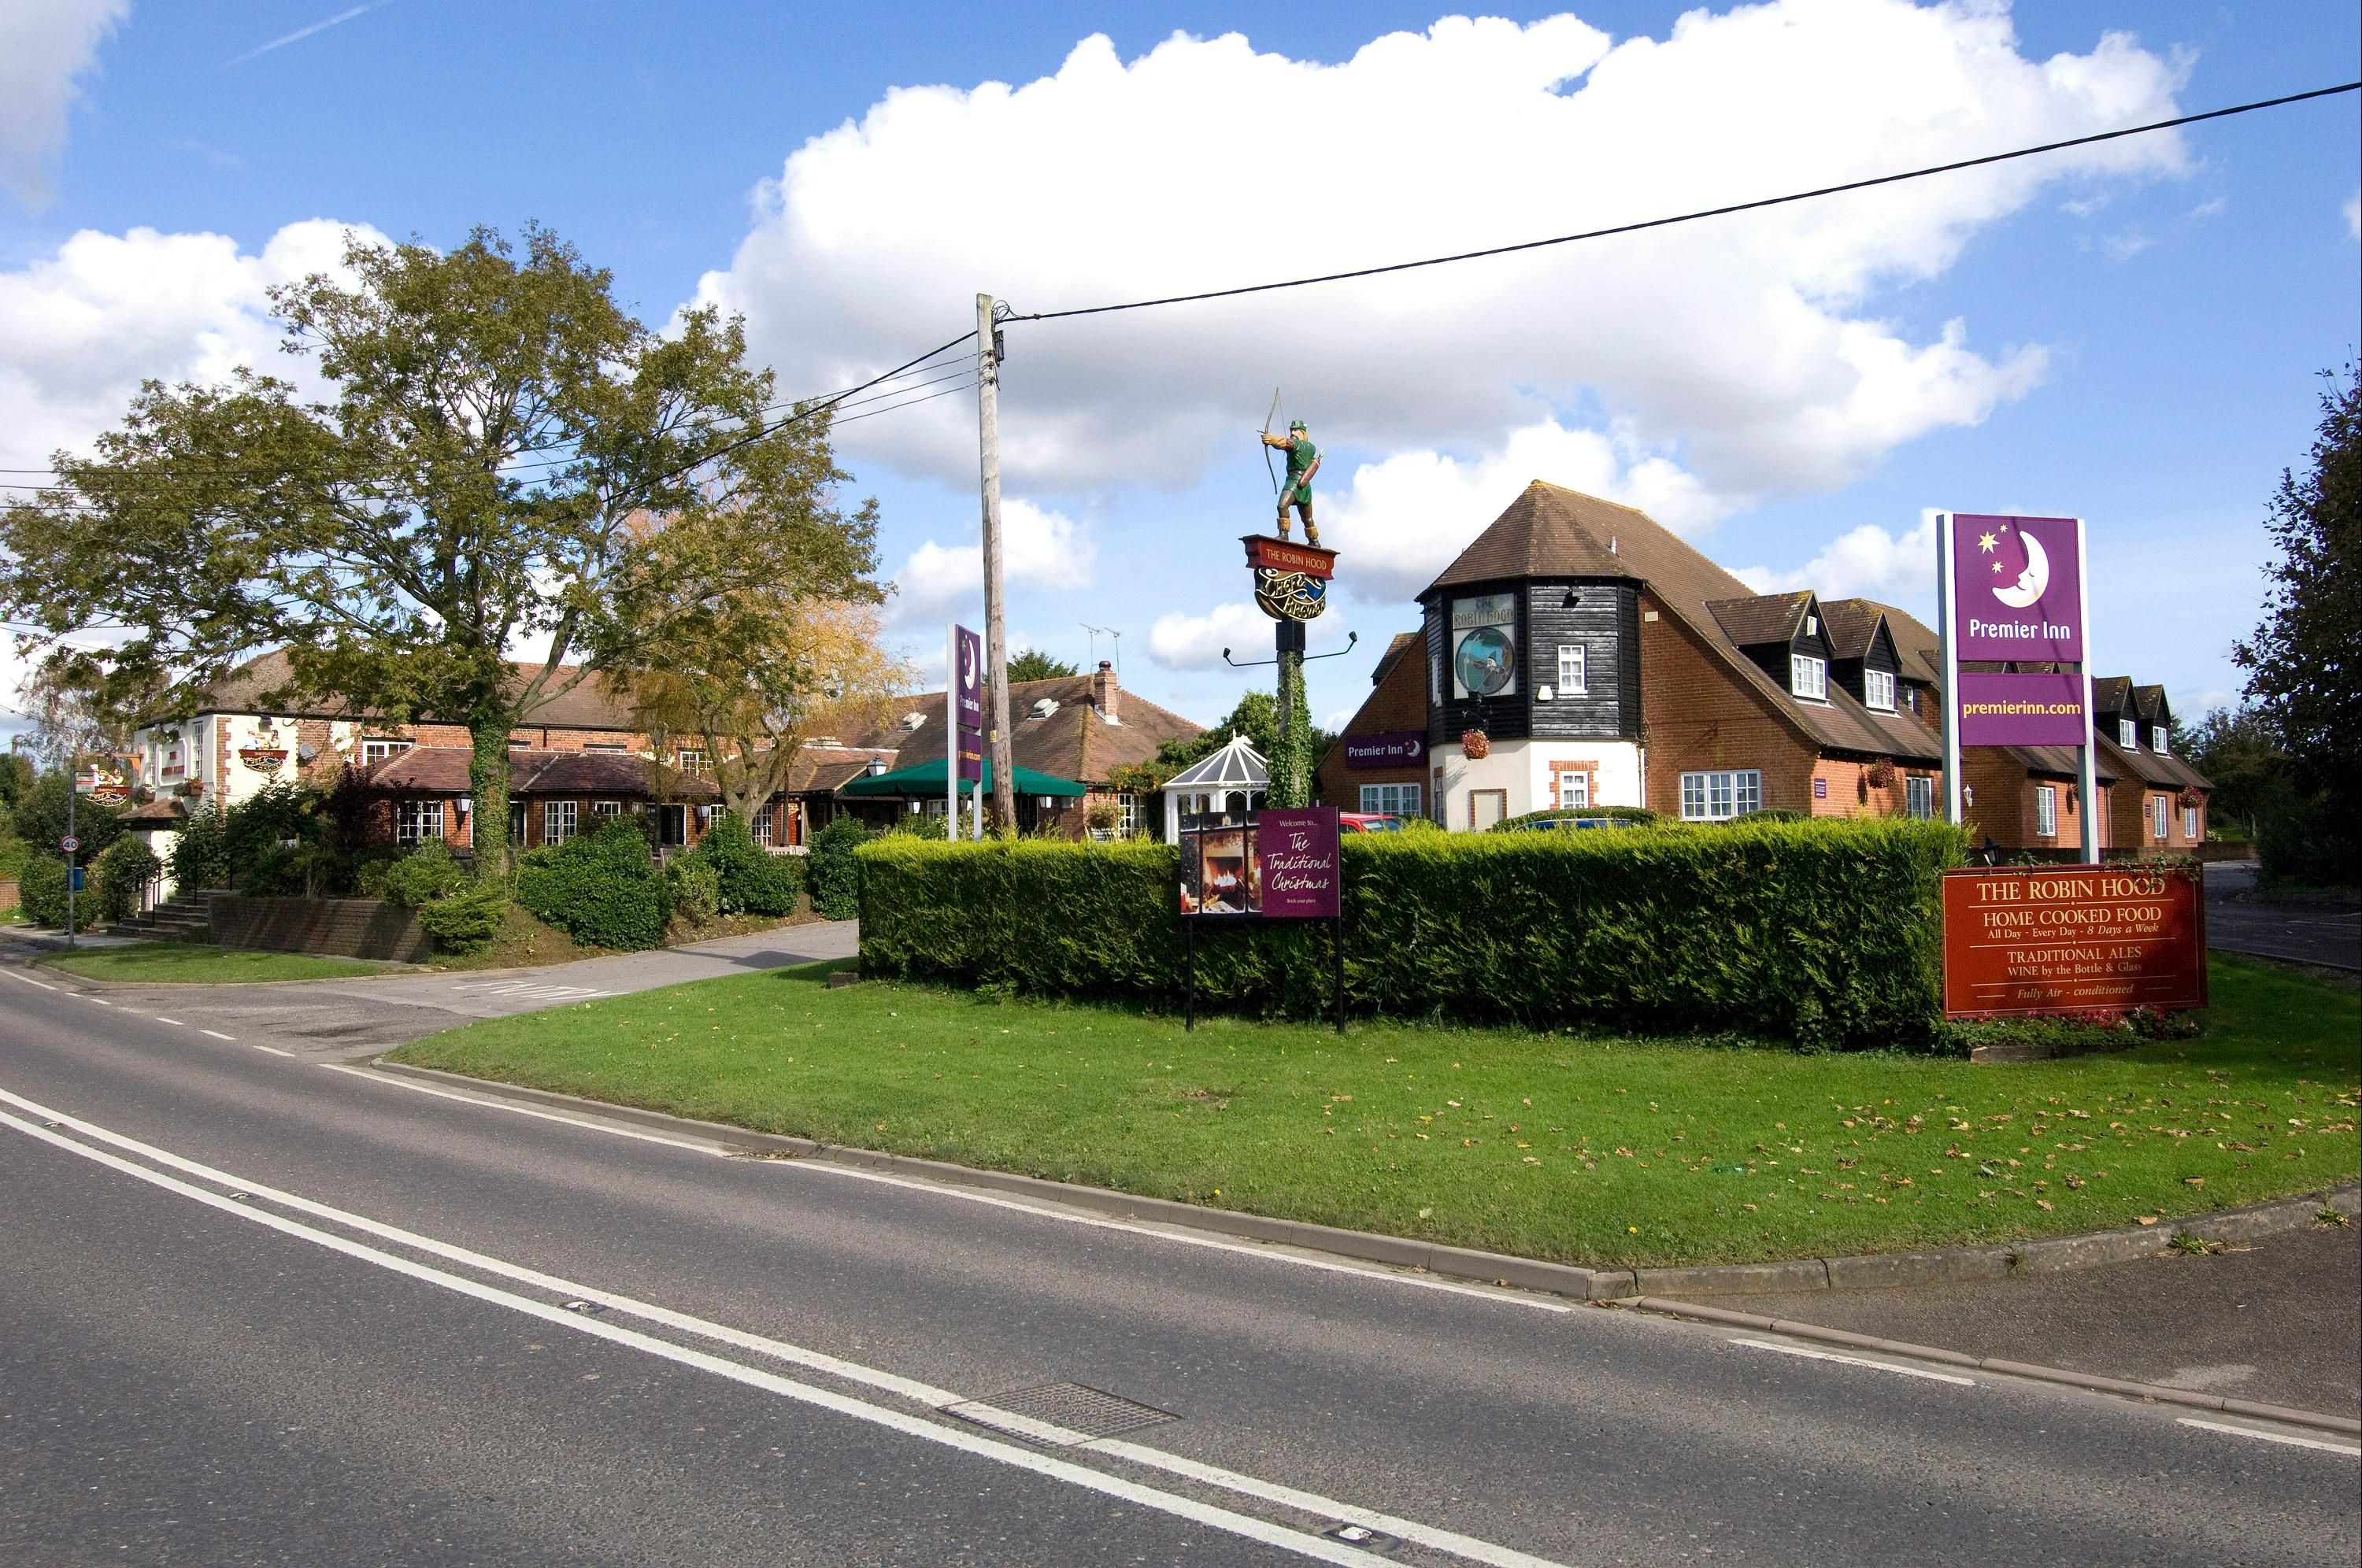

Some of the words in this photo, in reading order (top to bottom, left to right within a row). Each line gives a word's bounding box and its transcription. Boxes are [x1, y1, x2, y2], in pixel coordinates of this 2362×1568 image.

[1267, 549, 1279, 560] THE
[1283, 552, 1304, 566] ROBIN
[1306, 557, 1327, 570] HOOD
[1969, 619, 2038, 639] Premier
[2043, 621, 2071, 639] Inn
[1963, 700, 2081, 719] premierinn.com
[1349, 745, 1386, 757] Premier
[1388, 744, 1403, 755] Inn
[1289, 832, 1310, 851] The
[1267, 852, 1332, 870] Traditional
[1272, 871, 1329, 891] Christmas
[1977, 882, 2021, 901] THE
[2028, 879, 2094, 900] ROBIN
[2101, 878, 2165, 897] HOOD
[1984, 912, 2034, 927] HOME
[2039, 908, 2111, 925] COOKED
[2116, 907, 2162, 922] FOOD
[1987, 929, 2001, 939] All
[2005, 929, 2022, 940] Day
[2032, 927, 2057, 938] Every
[2060, 926, 2077, 937] Day
[2086, 925, 2094, 935] 8
[2097, 925, 2123, 937] Days
[2135, 923, 2159, 933] Week
[2008, 949, 2104, 963] TRADITIONAL
[2108, 946, 2142, 960] ALES
[2008, 966, 2038, 976] WINE
[2042, 965, 2053, 977] by
[2057, 964, 2071, 974] the
[2075, 963, 2103, 974] Bottle
[2105, 963, 2114, 972] &
[2118, 960, 2142, 971] Glass
[2017, 988, 2042, 1000] Fully
[2046, 988, 2063, 997] Air
[2073, 984, 2134, 997] conditioned
